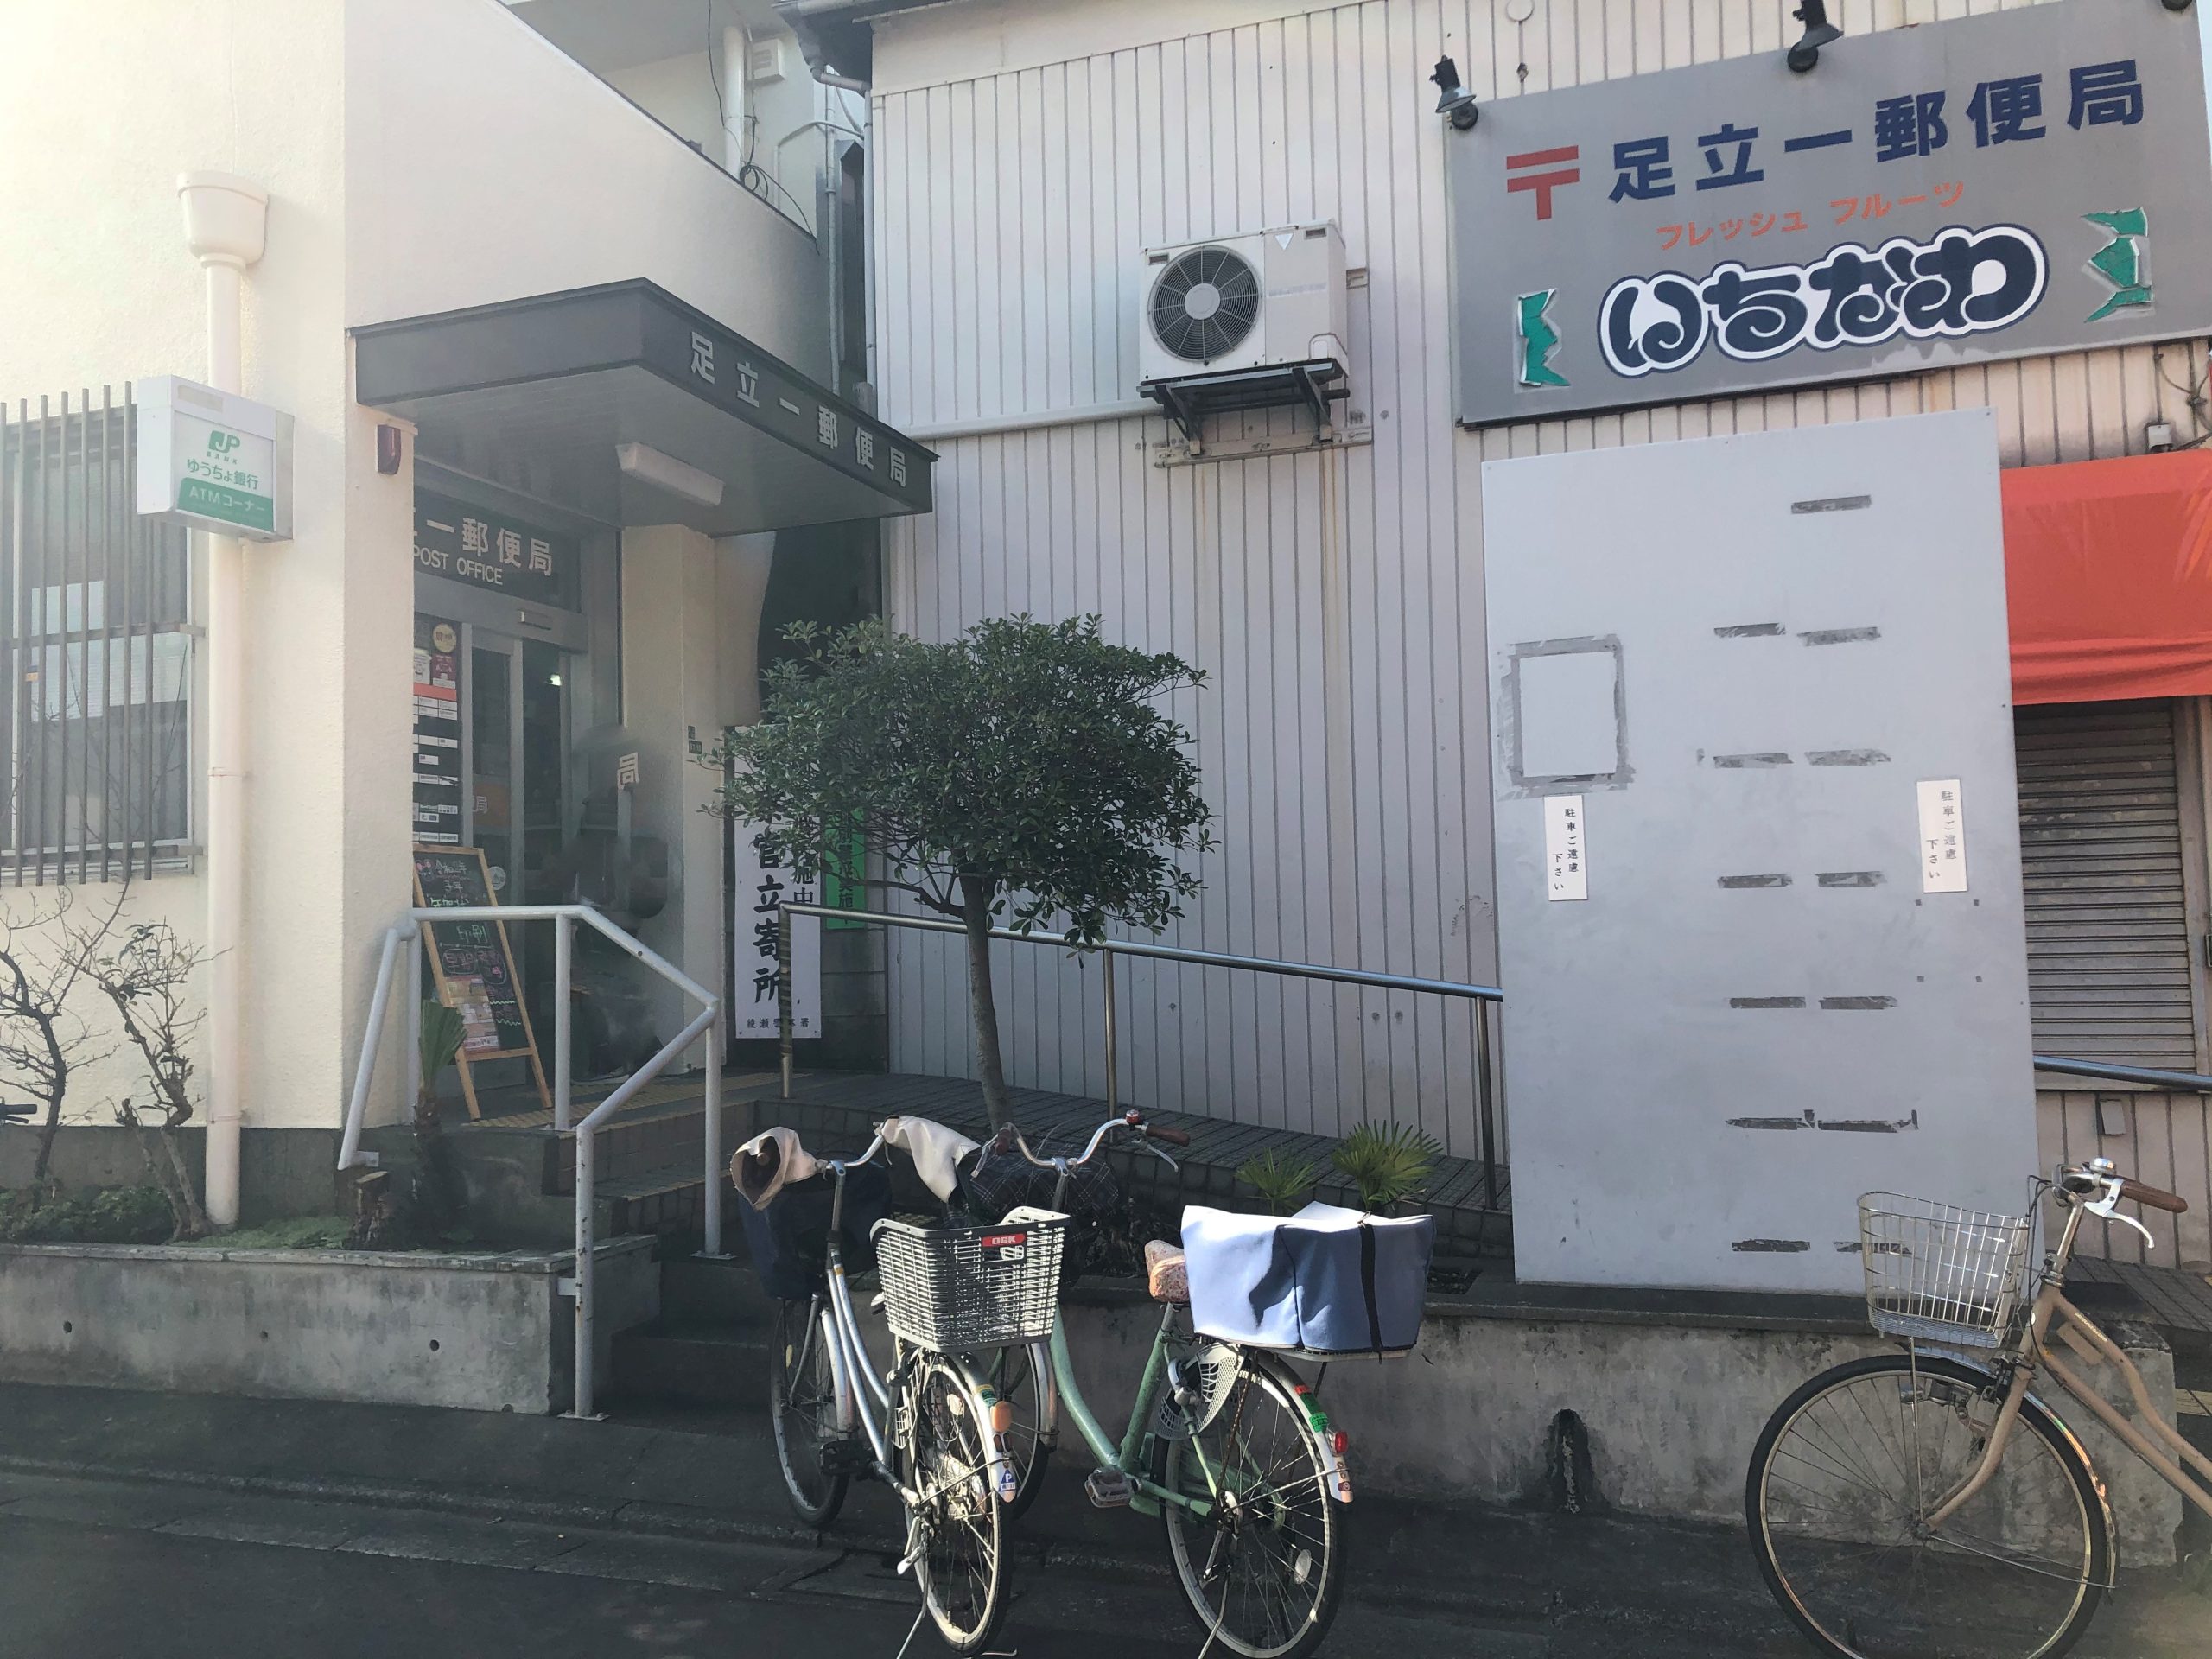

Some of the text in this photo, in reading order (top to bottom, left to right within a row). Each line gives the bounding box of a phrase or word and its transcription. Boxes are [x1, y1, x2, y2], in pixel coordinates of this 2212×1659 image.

[1656, 181, 1965, 251] フレッシュ フルーツ
[691, 331, 950, 487] 足立一郵便局
[187, 458, 258, 490] ゆうちょ銀行
[189, 486, 265, 512] ATMコーナー
[415, 507, 552, 576] 一郵便局
[414, 544, 503, 586] POST OFFICE
[1565, 808, 1580, 873] 駐車ご遠慮
[1941, 791, 1957, 859] 駐車ご遠慮
[1552, 853, 1565, 891] 下さい
[1926, 838, 1941, 879] 下さい
[992, 1236, 1016, 1245] OGK
